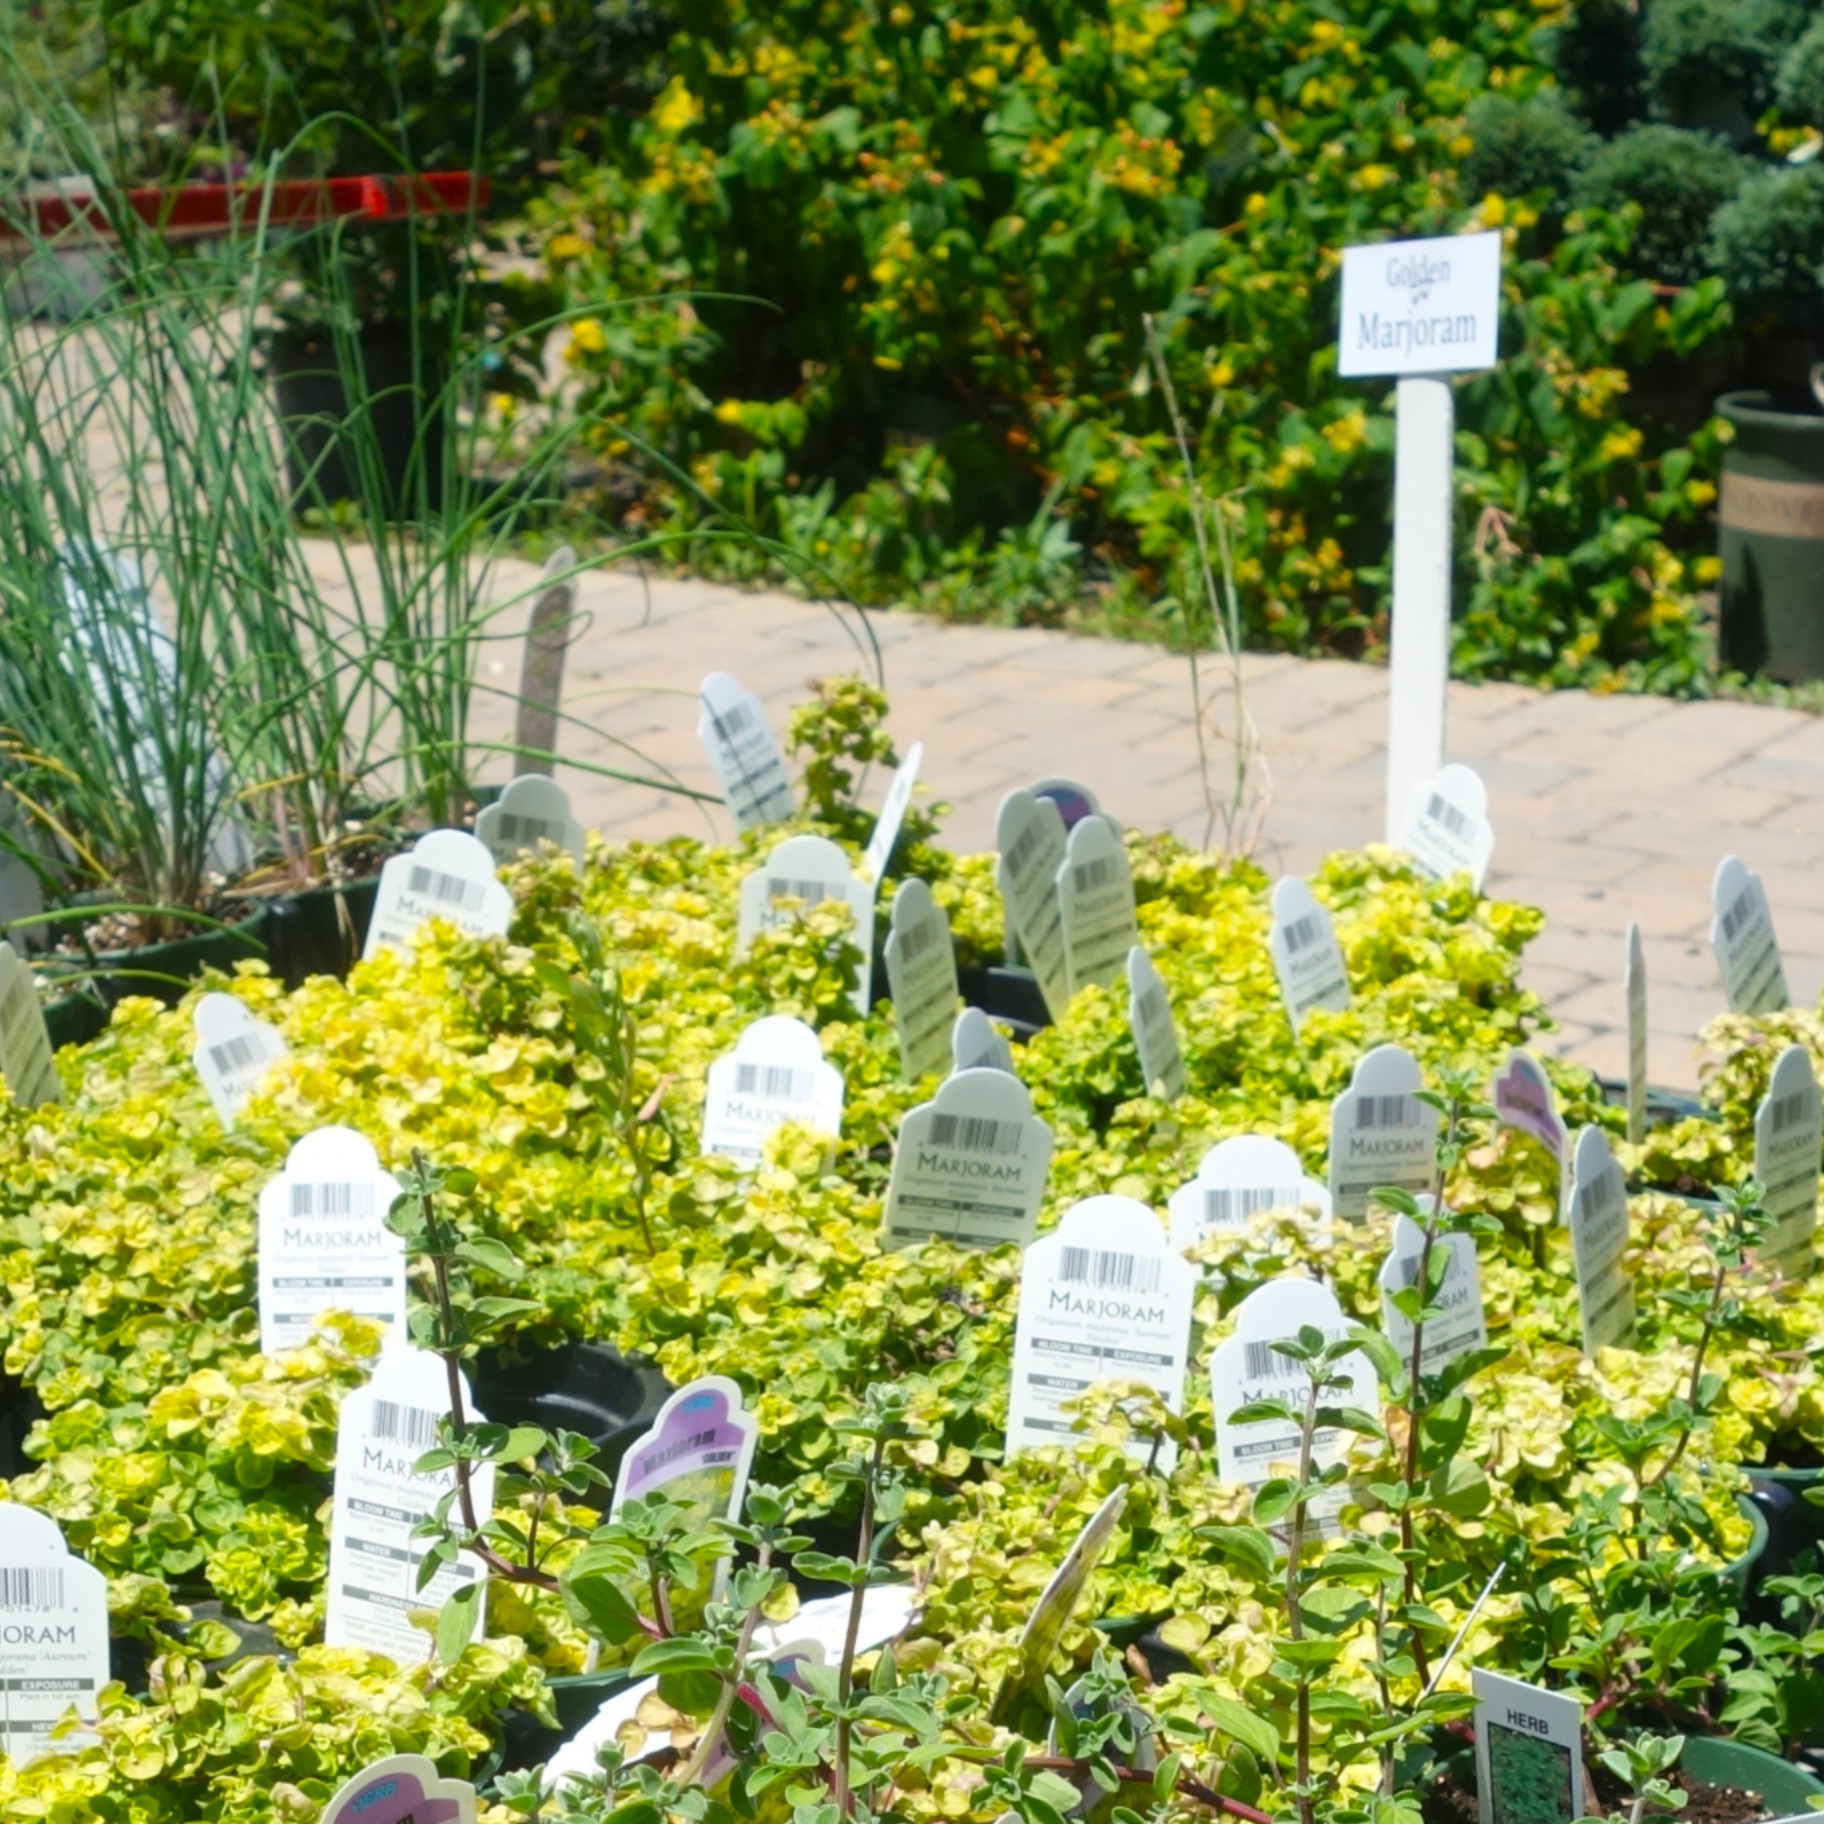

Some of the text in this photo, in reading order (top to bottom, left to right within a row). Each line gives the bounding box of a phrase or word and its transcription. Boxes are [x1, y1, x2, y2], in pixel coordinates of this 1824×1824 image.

[1387, 257, 1451, 288] Golden
[1357, 310, 1477, 357] Marjoram
[1350, 1138, 1425, 1158] MARJORAM
[917, 1151, 1023, 1182] MARJORAM
[283, 1227, 383, 1250] MARJORAM
[1048, 1288, 1166, 1325] MARJORAM
[363, 1446, 457, 1488] MARJORA
[21, 1680, 80, 1691] EXPOSURE
[1506, 1708, 1551, 1736] HERB
